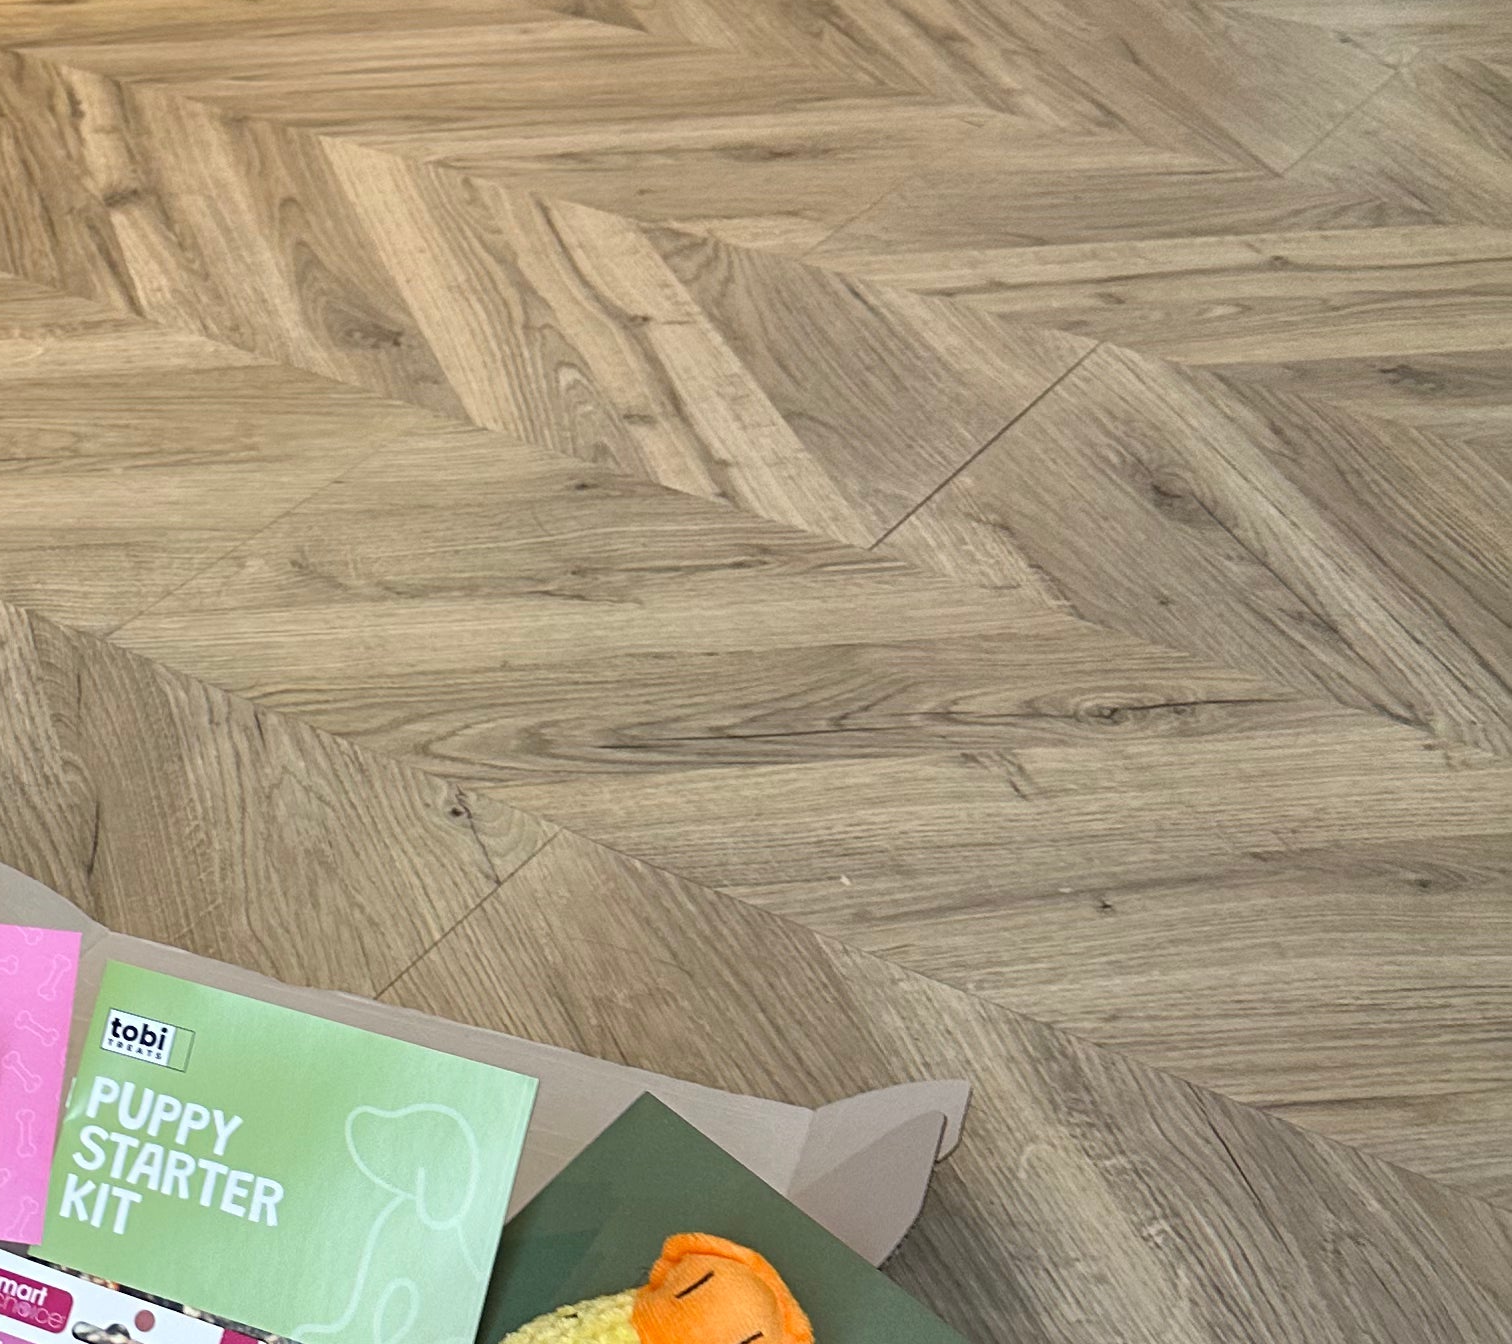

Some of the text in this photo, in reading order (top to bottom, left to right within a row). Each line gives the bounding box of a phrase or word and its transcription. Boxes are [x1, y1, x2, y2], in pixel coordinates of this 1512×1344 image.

[107, 1037, 162, 1060] TREATS
[110, 1017, 169, 1051] tobi
[85, 1075, 244, 1157] PUPPY
[59, 1172, 143, 1236] KIT
[72, 1124, 284, 1227] STARTER
